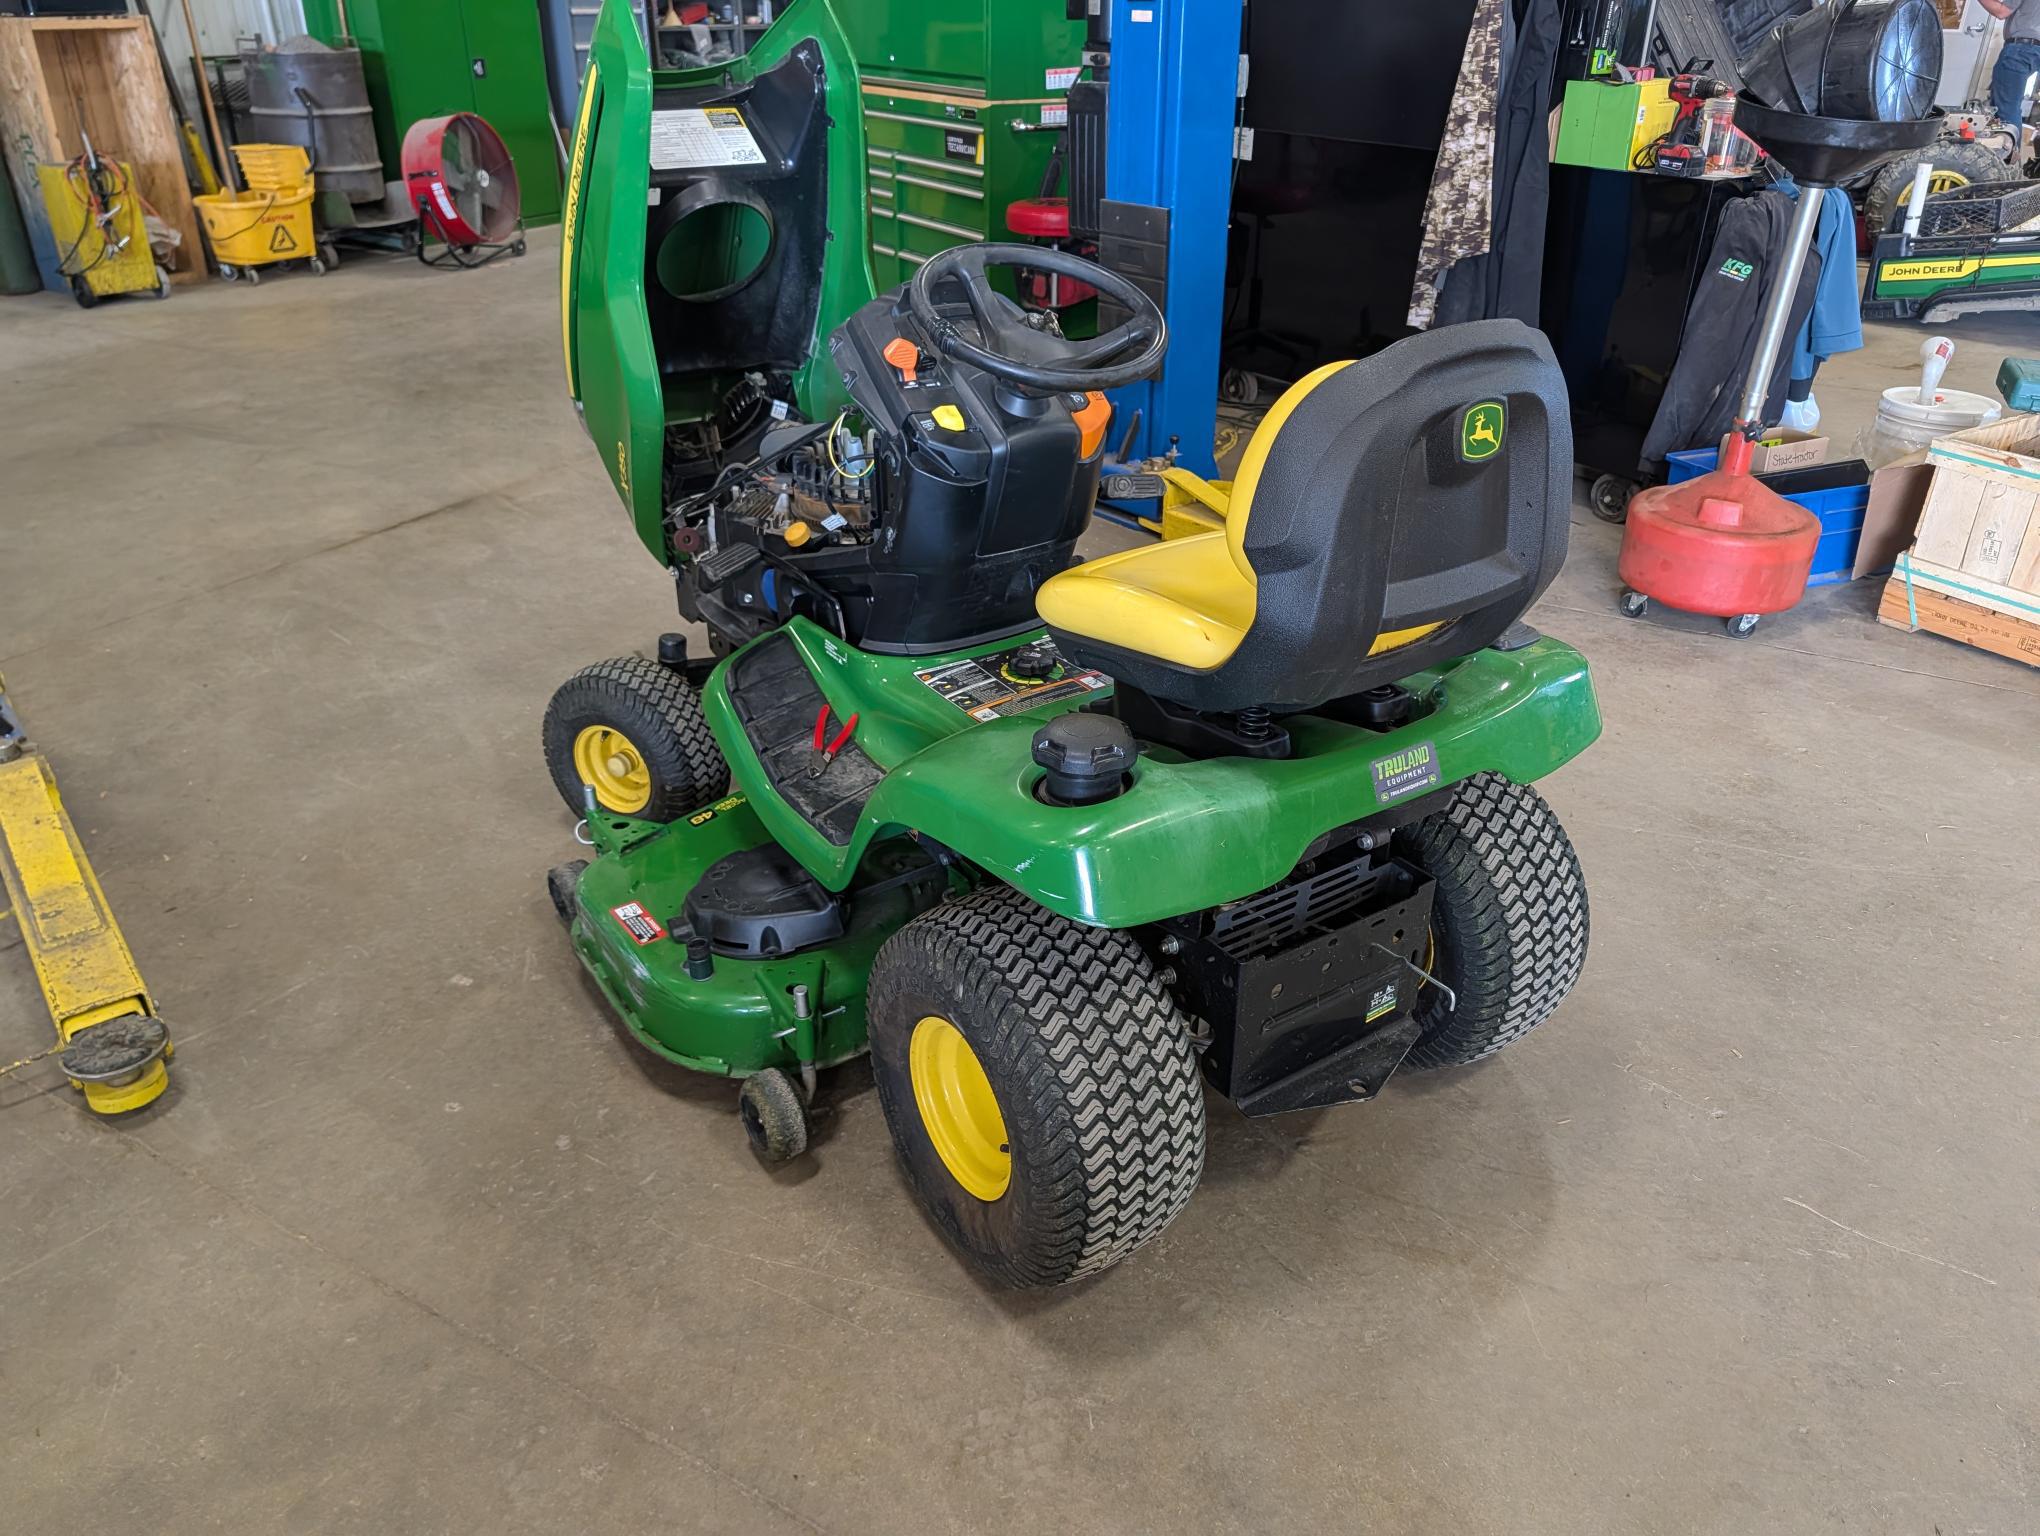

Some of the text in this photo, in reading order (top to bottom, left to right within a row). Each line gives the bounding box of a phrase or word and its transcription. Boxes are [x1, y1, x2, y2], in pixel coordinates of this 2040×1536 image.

[571, 123, 588, 194] DEERE
[1723, 257, 1754, 275] KFG
[1888, 264, 1963, 276] JOHN DEERE
[1375, 745, 1430, 780] TRULAND
[1386, 766, 1426, 787] EQUIPMENT
[690, 811, 713, 825] 48
